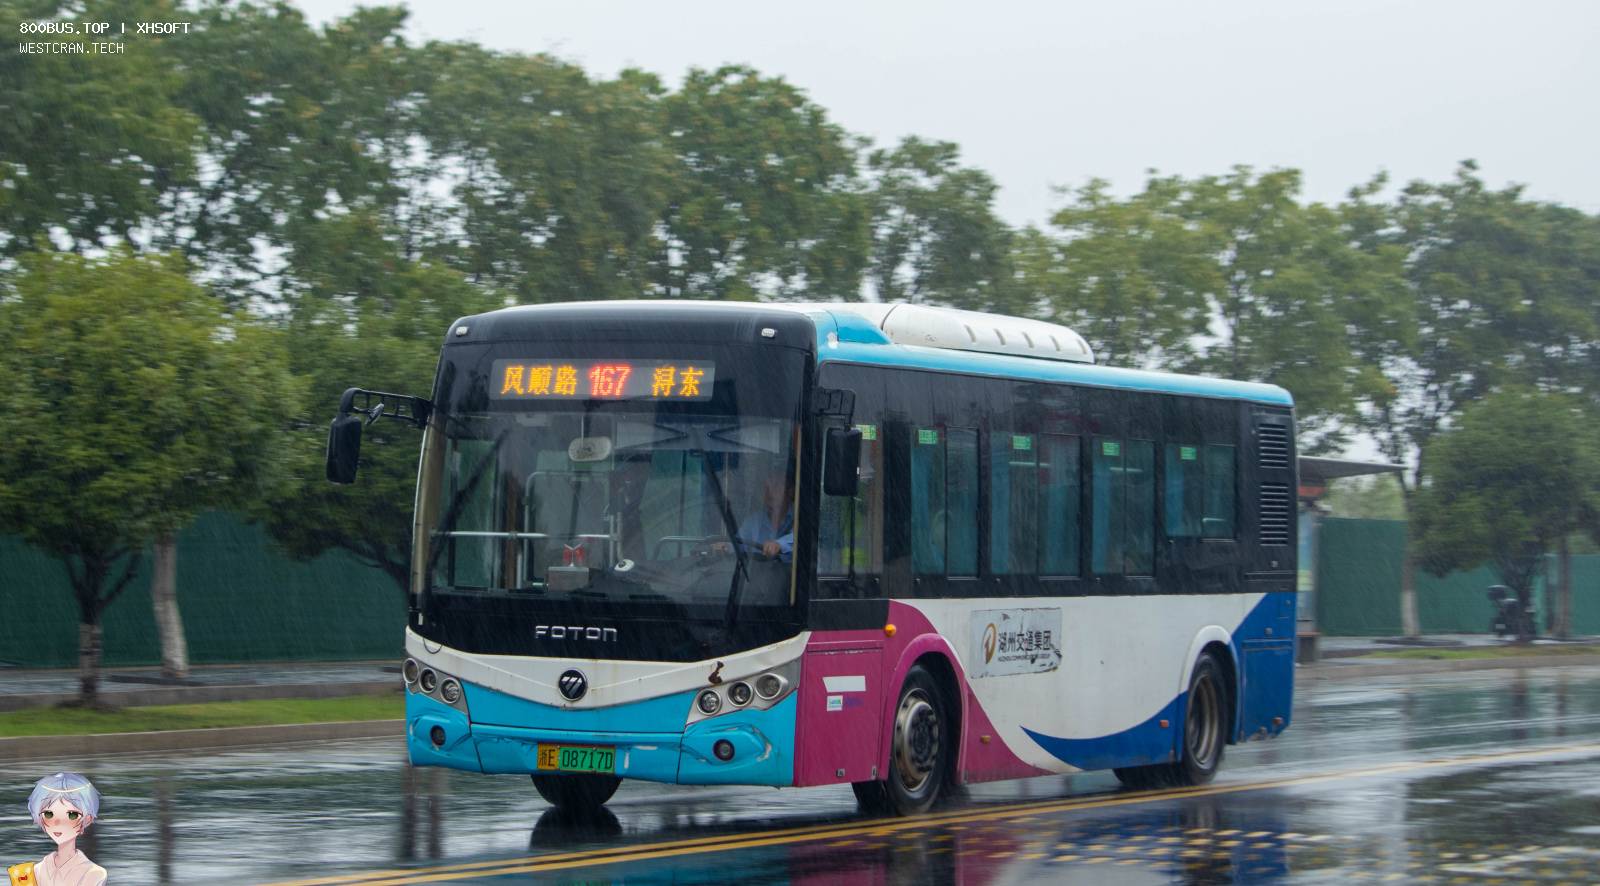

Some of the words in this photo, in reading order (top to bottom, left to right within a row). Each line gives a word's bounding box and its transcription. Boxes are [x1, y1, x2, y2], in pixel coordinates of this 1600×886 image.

[589, 363, 632, 397] 167
[652, 365, 704, 397] 浔东
[535, 625, 618, 642] FOTON
[998, 630, 1052, 653] 湖州交通集团
[562, 750, 613, 770] 08717D
